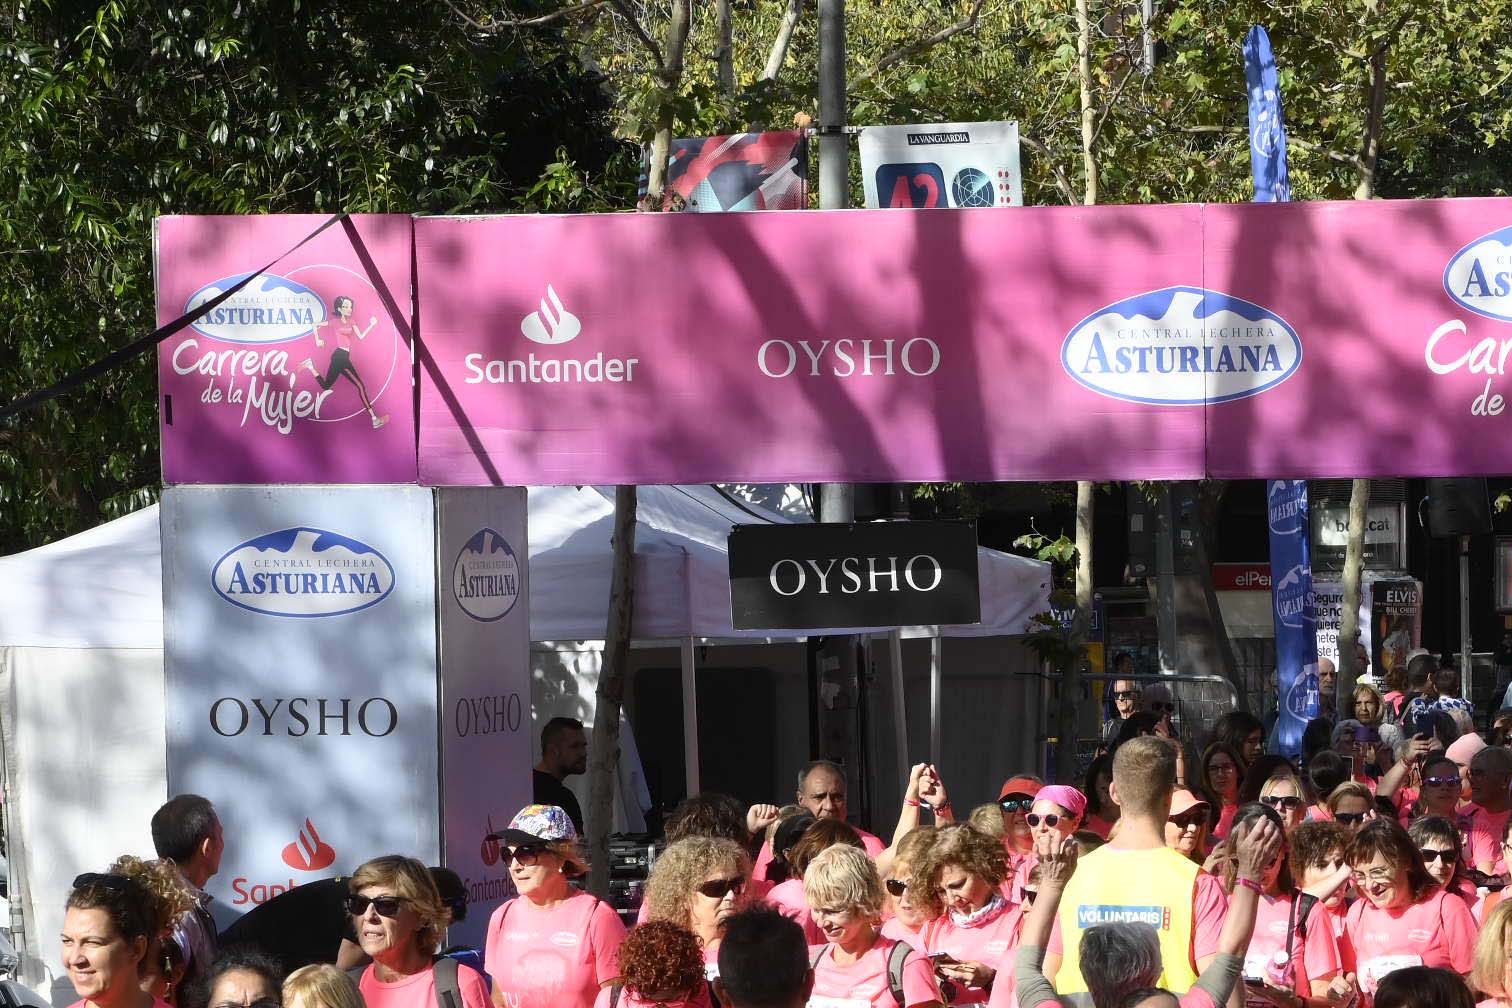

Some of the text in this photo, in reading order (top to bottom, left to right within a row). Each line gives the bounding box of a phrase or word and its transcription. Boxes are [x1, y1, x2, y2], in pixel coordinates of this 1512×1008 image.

[920, 133, 969, 144] VANGUARDIA
[194, 298, 315, 325] ASTURIANA
[1117, 327, 1276, 339] CENTRAL LECHERA
[172, 339, 290, 376] Carrera
[464, 353, 639, 384] Santander
[756, 337, 941, 378] OYSHO
[1081, 332, 1283, 373] ASTURIANA
[201, 372, 334, 435] de la Mujer
[1471, 379, 1505, 417] de
[226, 561, 382, 595] ASTURIANA
[255, 558, 376, 568] CENTRAL LECHERA
[769, 554, 943, 597] OYSHO
[458, 570, 517, 599] ASTURIANA
[1386, 590, 1417, 603] ELVIS
[209, 697, 398, 737] OYSHO
[455, 692, 522, 738] OYSHO
